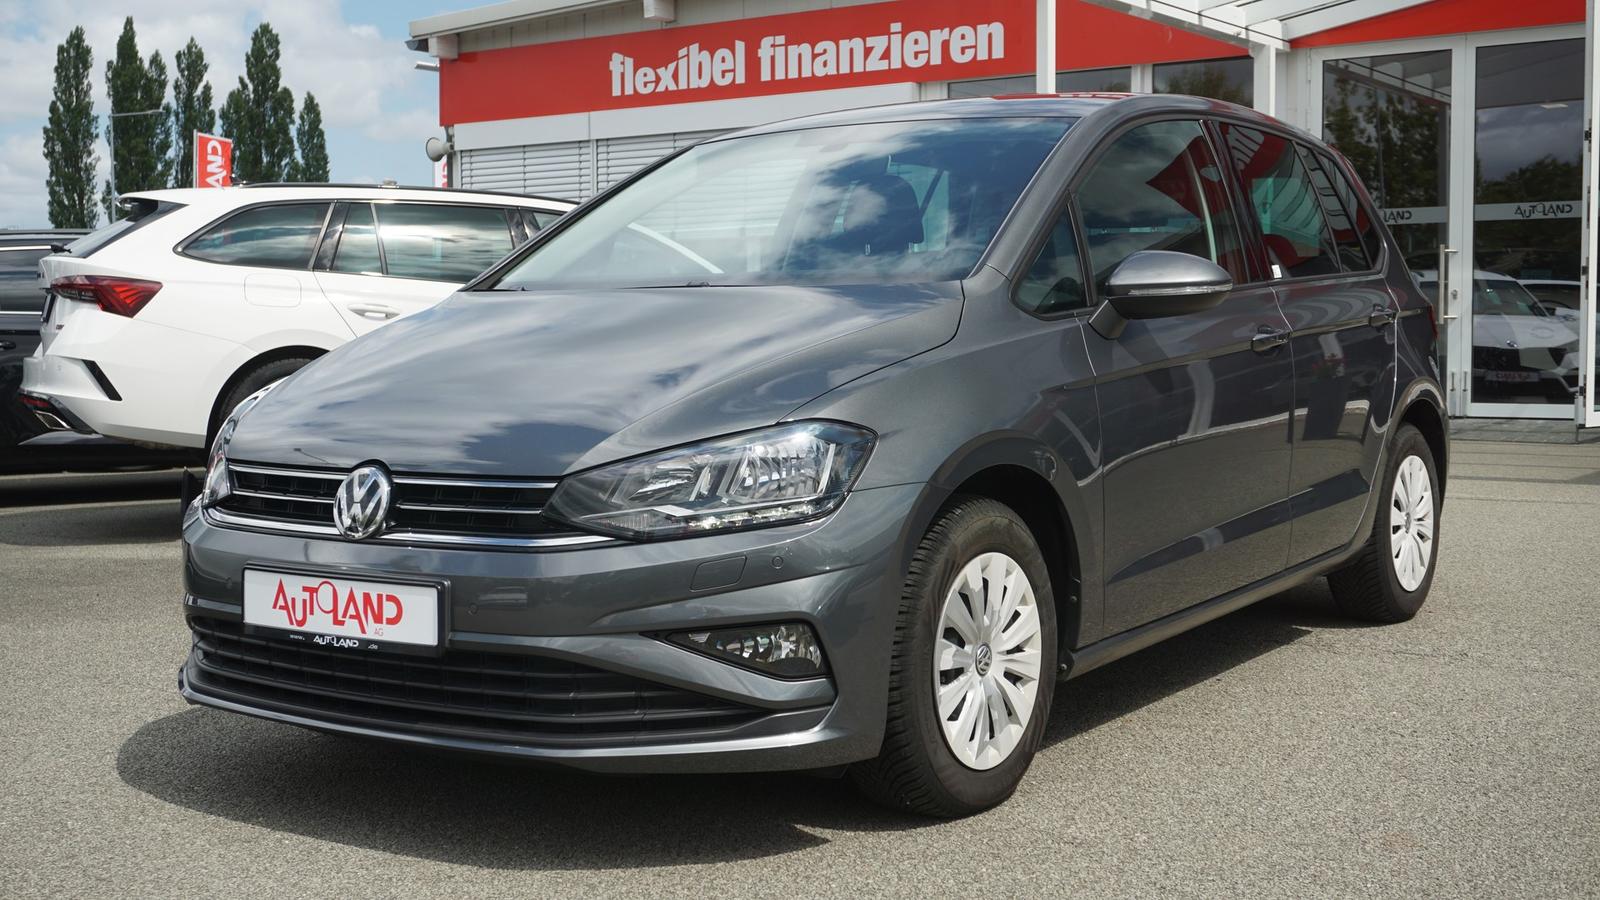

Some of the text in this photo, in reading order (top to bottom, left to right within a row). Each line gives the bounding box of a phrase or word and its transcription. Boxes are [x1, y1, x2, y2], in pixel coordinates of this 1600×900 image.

[609, 20, 1005, 97] flexibel finanzieren
[1514, 203, 1573, 218] AUTOLAND
[333, 466, 390, 539] VW
[272, 578, 403, 634] AUTOLAND
[313, 635, 359, 648] AUTOLAND
[374, 628, 384, 637] AG
